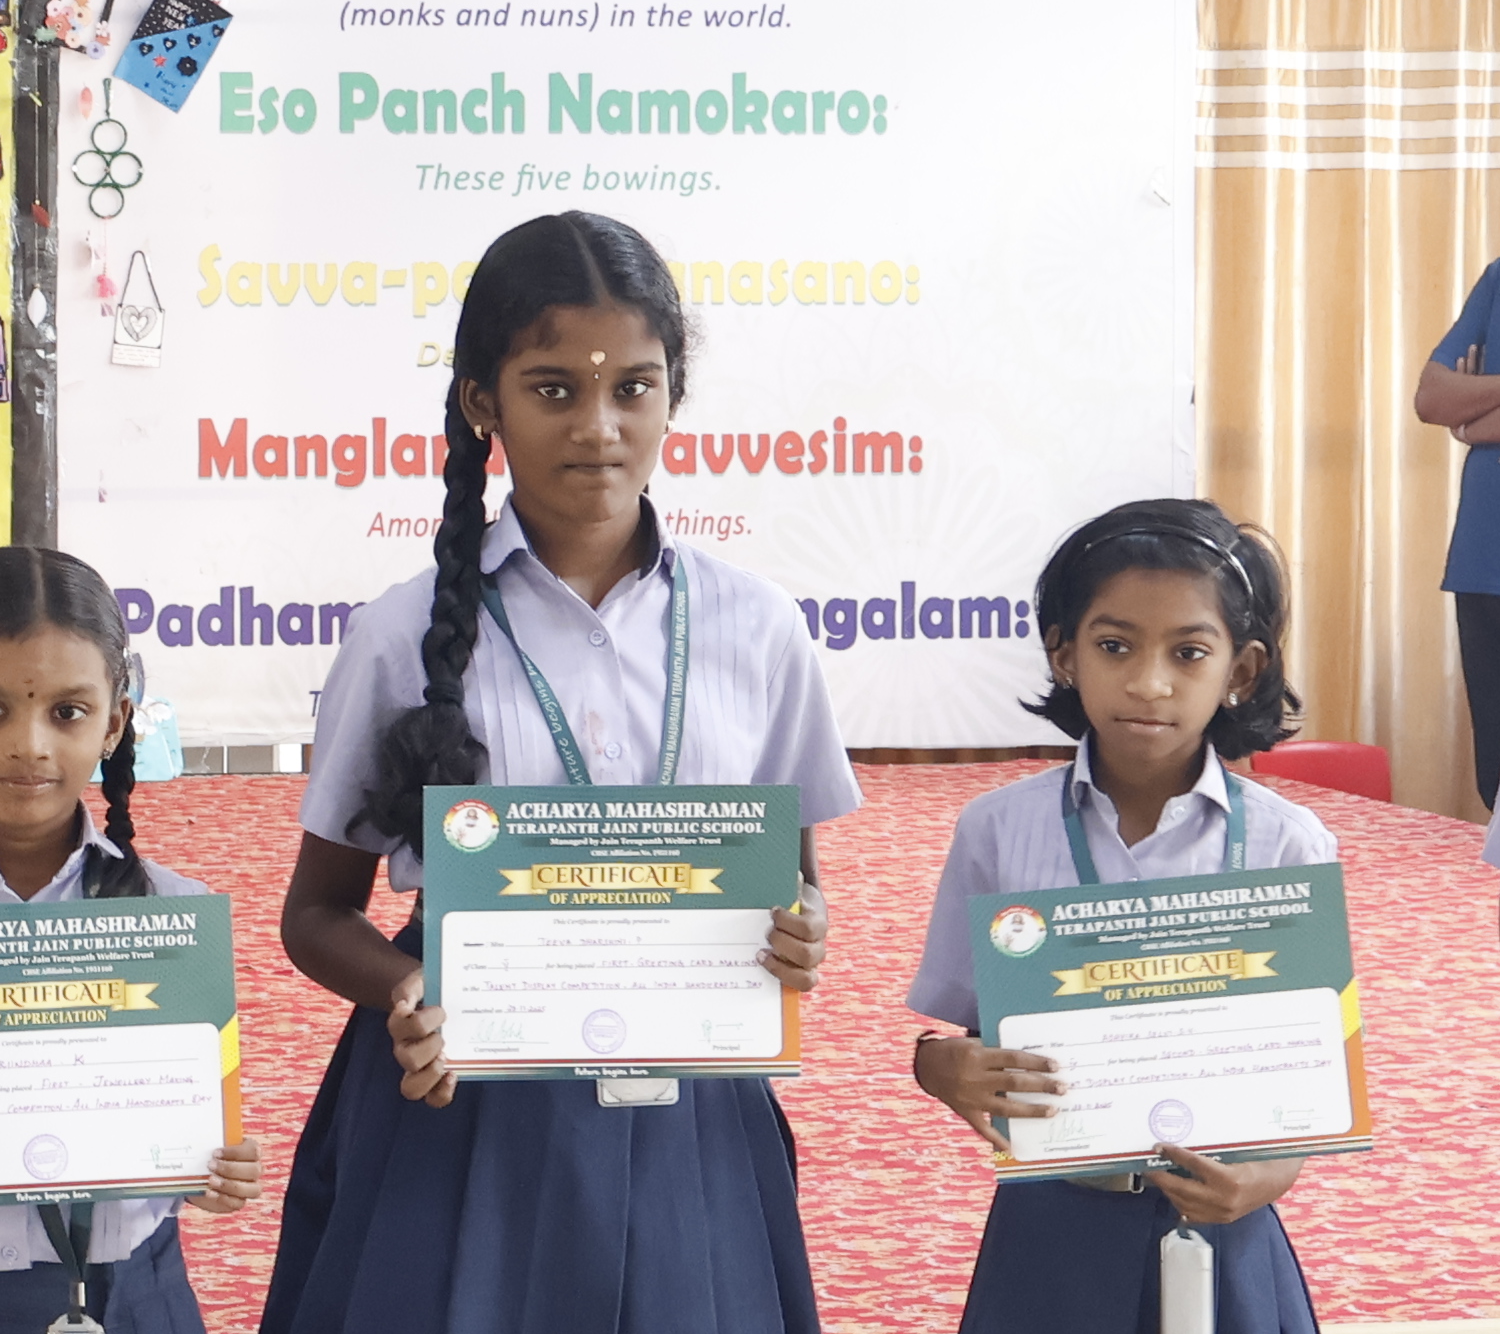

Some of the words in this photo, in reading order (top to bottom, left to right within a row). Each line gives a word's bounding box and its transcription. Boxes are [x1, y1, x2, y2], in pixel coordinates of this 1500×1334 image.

[165, 6, 187, 21] NEW
[340, 1, 444, 31] (monks
[456, 3, 510, 28] and
[520, 3, 599, 32] nuns)
[611, 4, 633, 27] in
[646, 4, 691, 28] the
[704, 5, 792, 29] world.
[217, 72, 316, 134] Eso
[339, 72, 525, 134] Panch
[548, 72, 888, 135] Namokaro:
[415, 164, 506, 194] These
[516, 163, 576, 194] five
[583, 164, 722, 198] bowings.
[662, 416, 923, 475] avvesim:
[795, 581, 1030, 650] ngalam:
[506, 802, 601, 820] ACHARYA
[606, 802, 765, 820] MAHASHRAMAN
[537, 865, 686, 887] CERTIFICATE
[1052, 899, 1147, 922] ACHARYA
[1151, 883, 1311, 913] MAHASHRAMAN
[36, 913, 196, 935] MAHASHRAMAN
[1090, 951, 1239, 982] CERTIFICATE
